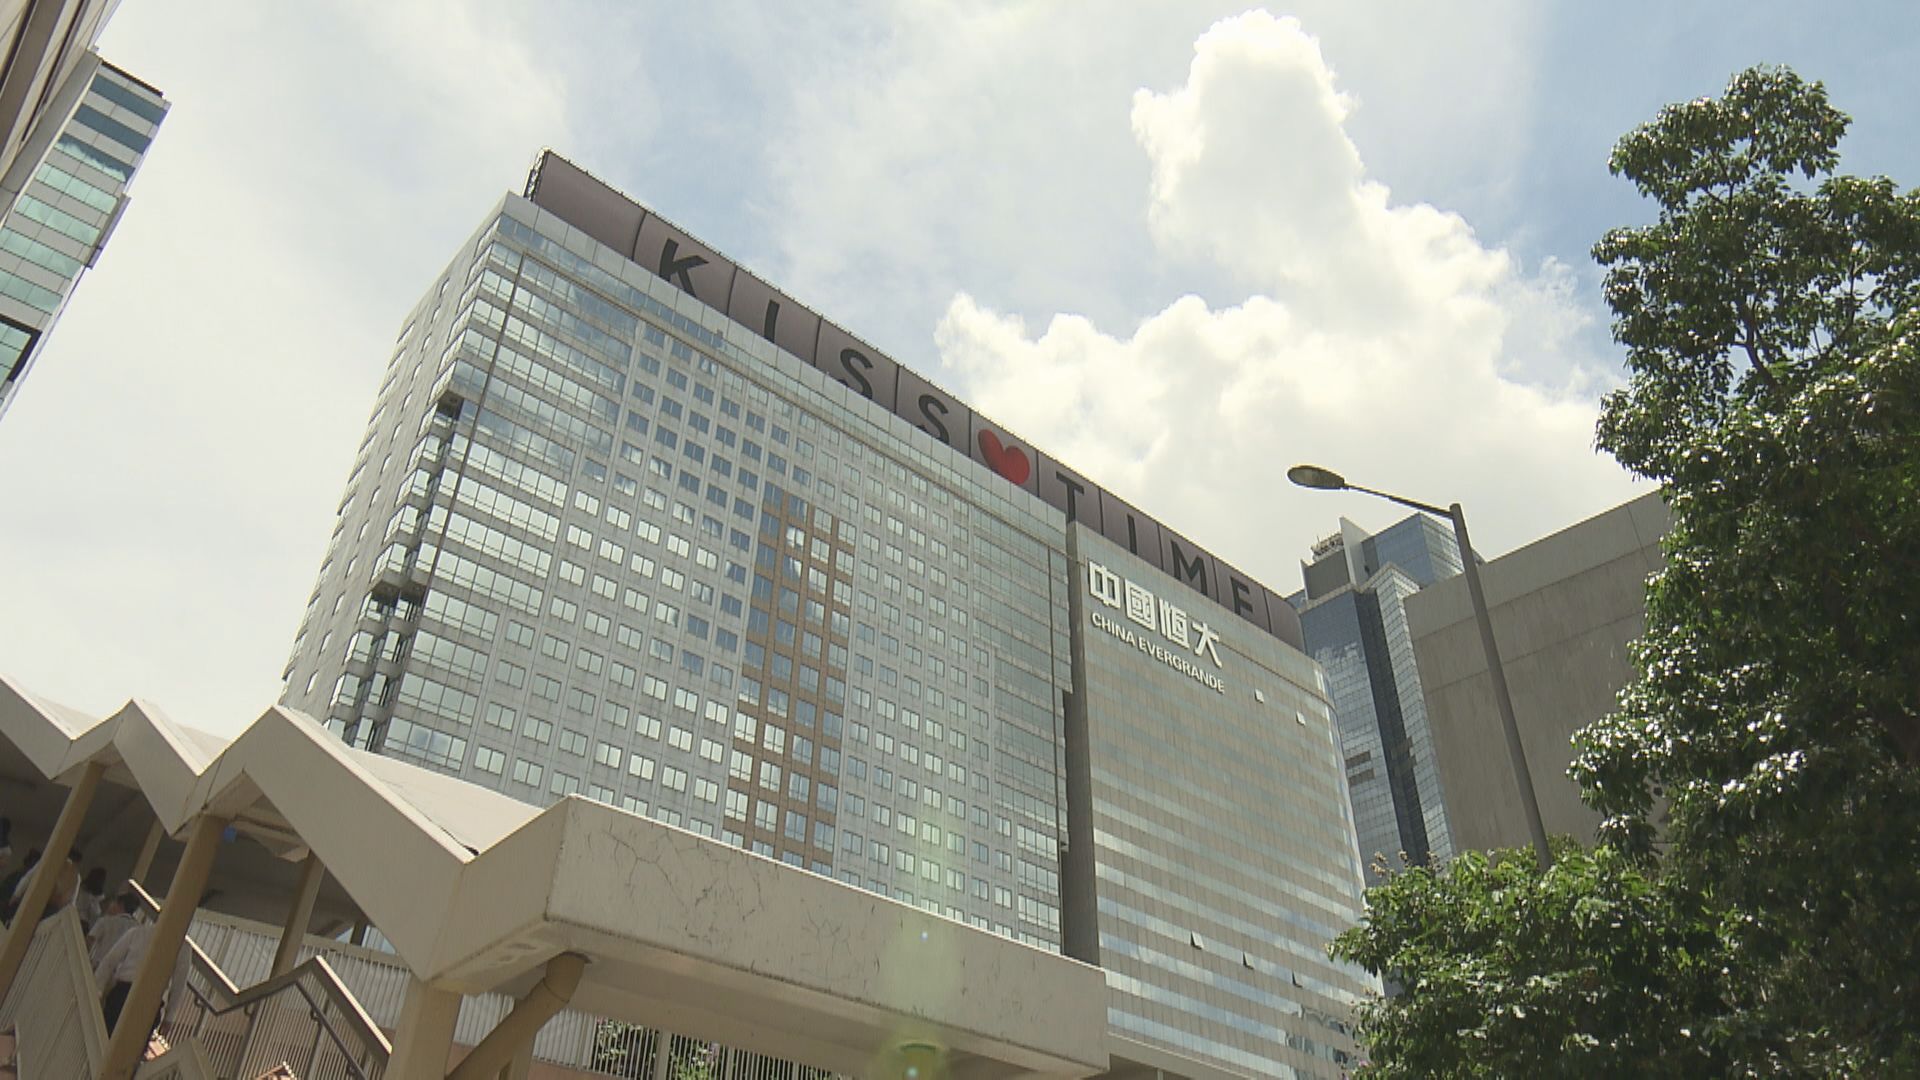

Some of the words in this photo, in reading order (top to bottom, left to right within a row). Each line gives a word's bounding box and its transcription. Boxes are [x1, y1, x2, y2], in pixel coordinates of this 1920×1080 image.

[660, 238, 949, 444] KISS
[1091, 612, 1136, 646] CHINA
[1138, 637, 1225, 694] EVERGRANDE
